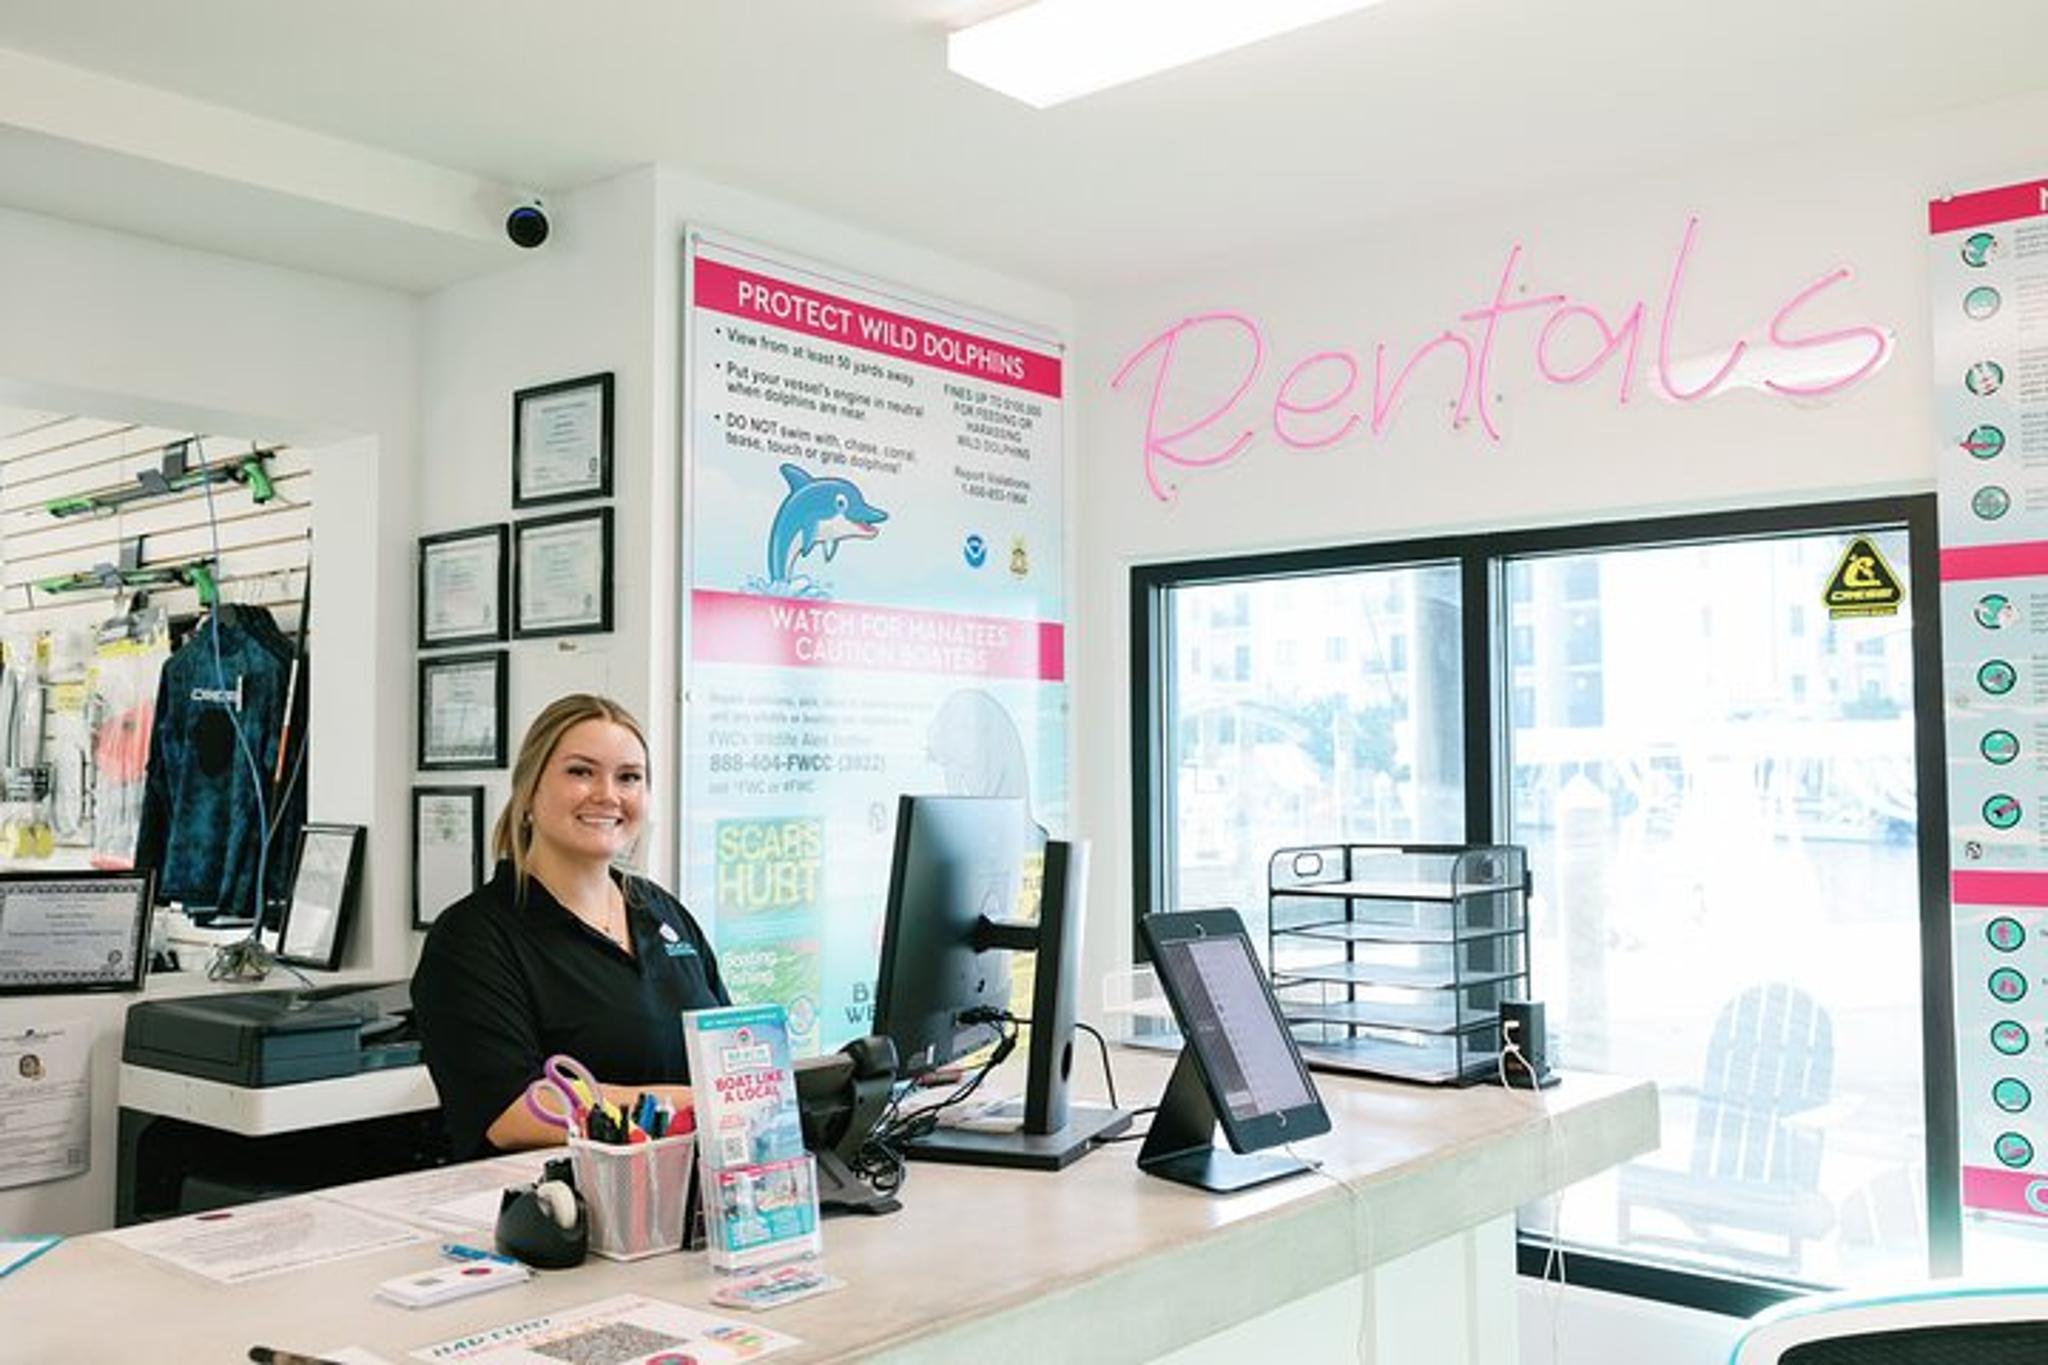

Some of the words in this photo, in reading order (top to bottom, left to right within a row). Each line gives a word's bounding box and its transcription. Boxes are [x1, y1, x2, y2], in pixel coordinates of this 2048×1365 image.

[738, 280, 853, 335] PROTECT
[858, 312, 917, 352] WILD
[923, 334, 1026, 380] DOLPHINS
[727, 327, 757, 347] View
[761, 335, 789, 355] from
[793, 345, 804, 359] at
[807, 347, 834, 366] least
[838, 355, 851, 371] 50
[853, 361, 884, 379] yards
[1110, 216, 1887, 502] Rentals
[727, 360, 749, 379] Put
[752, 368, 780, 386] your
[784, 377, 831, 398] vessel's
[833, 387, 872, 408] engine
[874, 395, 885, 409] in
[887, 397, 925, 418] neutral
[727, 380, 761, 399] when
[764, 388, 817, 412] dolphins
[819, 401, 838, 415] are
[726, 412, 747, 430] DO
[751, 417, 778, 436] NOT
[780, 426, 811, 444] swim
[766, 438, 802, 457] touch
[804, 446, 819, 460] or
[820, 449, 847, 466] grab
[769, 606, 856, 636] WATCH
[861, 613, 902, 636] FOR
[911, 617, 1009, 647] MANATEES
[795, 637, 890, 666] CAUTION
[894, 645, 989, 672] BOATERS
[708, 752, 833, 774] 888-404-FWCC
[718, 820, 823, 864] SCARS
[717, 859, 823, 909] HURT
[714, 1073, 753, 1093] BOAT
[756, 1069, 786, 1085] LIKE
[724, 1091, 735, 1104] A
[737, 1085, 782, 1103] LOCAL
